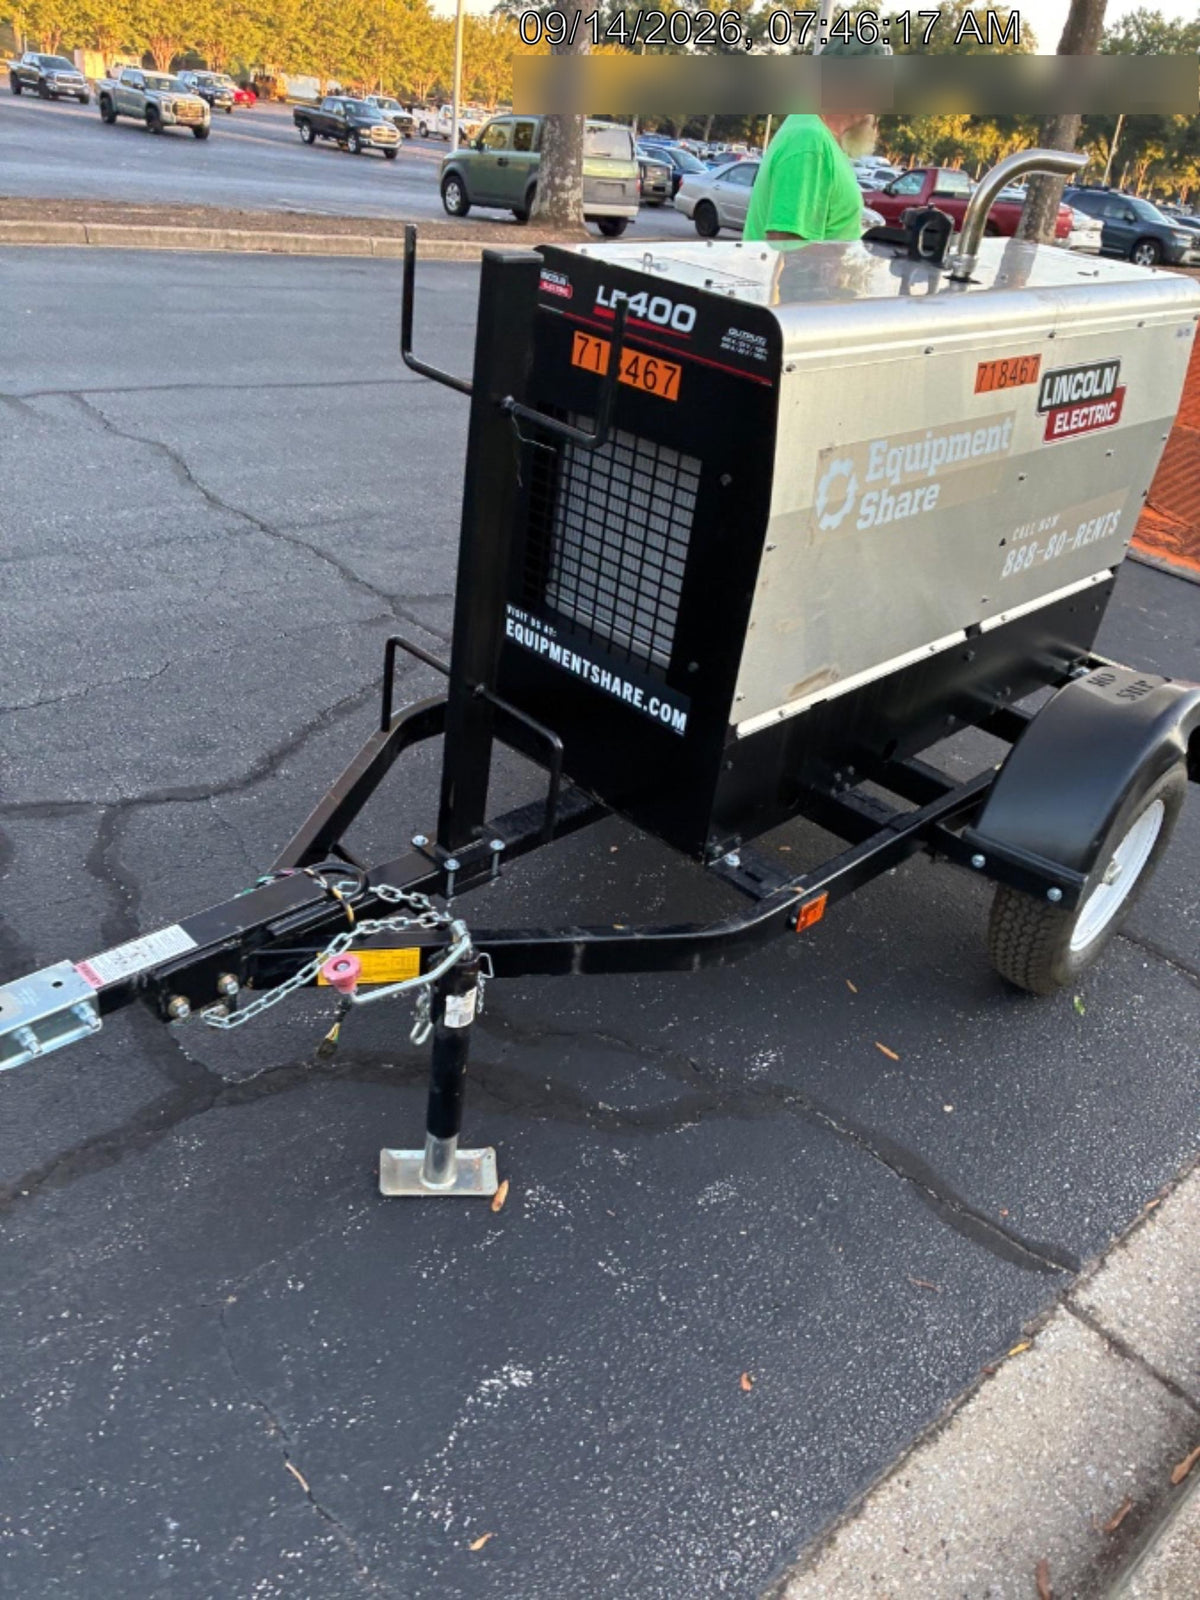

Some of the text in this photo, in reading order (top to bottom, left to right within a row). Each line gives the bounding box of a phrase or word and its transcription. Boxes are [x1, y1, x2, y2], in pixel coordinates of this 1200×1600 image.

[577, 335, 678, 395] 71467
[977, 356, 1041, 390] 718467
[1041, 366, 1117, 407] LINCOLN
[1053, 401, 1117, 434] ELECTRIC
[864, 417, 1013, 485] Equipment
[856, 481, 940, 531] Share
[1001, 509, 1122, 578] 888-80-RENTS
[505, 618, 688, 732] EQUIPMENTSHARE.COM
